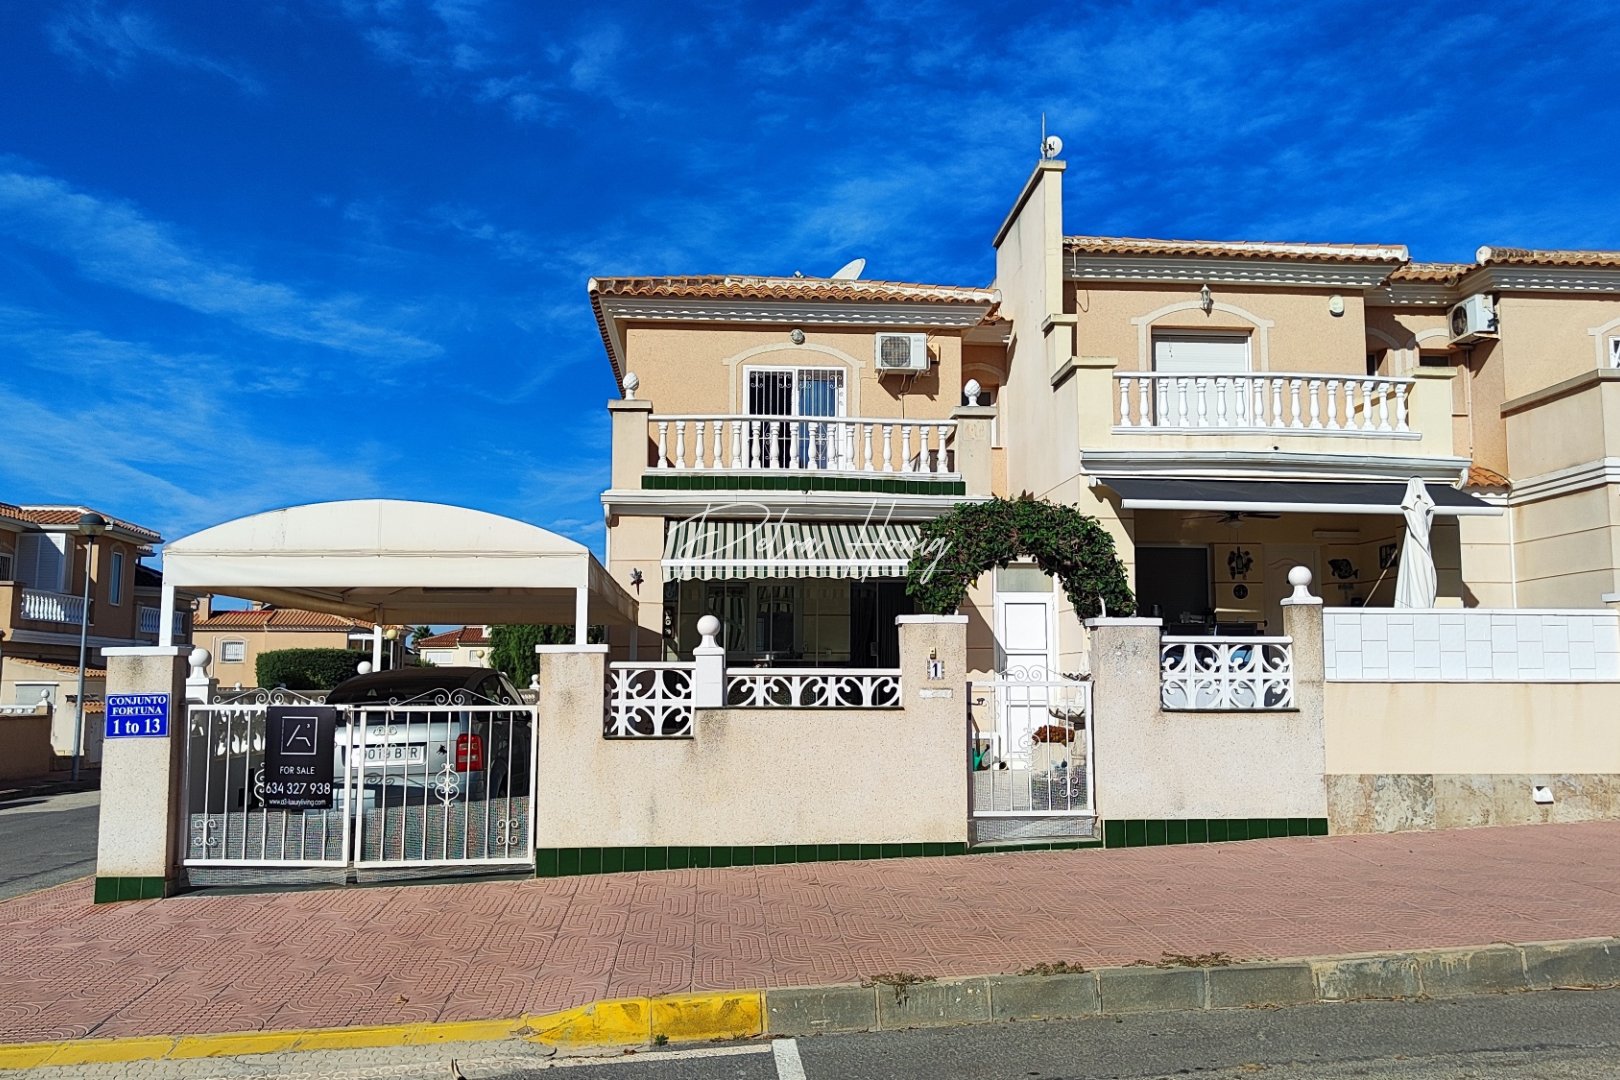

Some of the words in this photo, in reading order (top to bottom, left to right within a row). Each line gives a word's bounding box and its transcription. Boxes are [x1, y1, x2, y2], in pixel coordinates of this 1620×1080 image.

[932, 663, 938, 677] 1
[109, 696, 166, 705] CONJUNTO
[112, 706, 162, 715] FORTUNA
[113, 719, 120, 734] 1
[125, 721, 139, 734] to
[144, 718, 160, 733] 13
[364, 748, 391, 760] 019
[280, 766, 294, 775] FOR
[296, 766, 315, 775] SALE
[266, 782, 284, 794] 634
[286, 782, 306, 794] 327
[310, 782, 331, 794] 938
